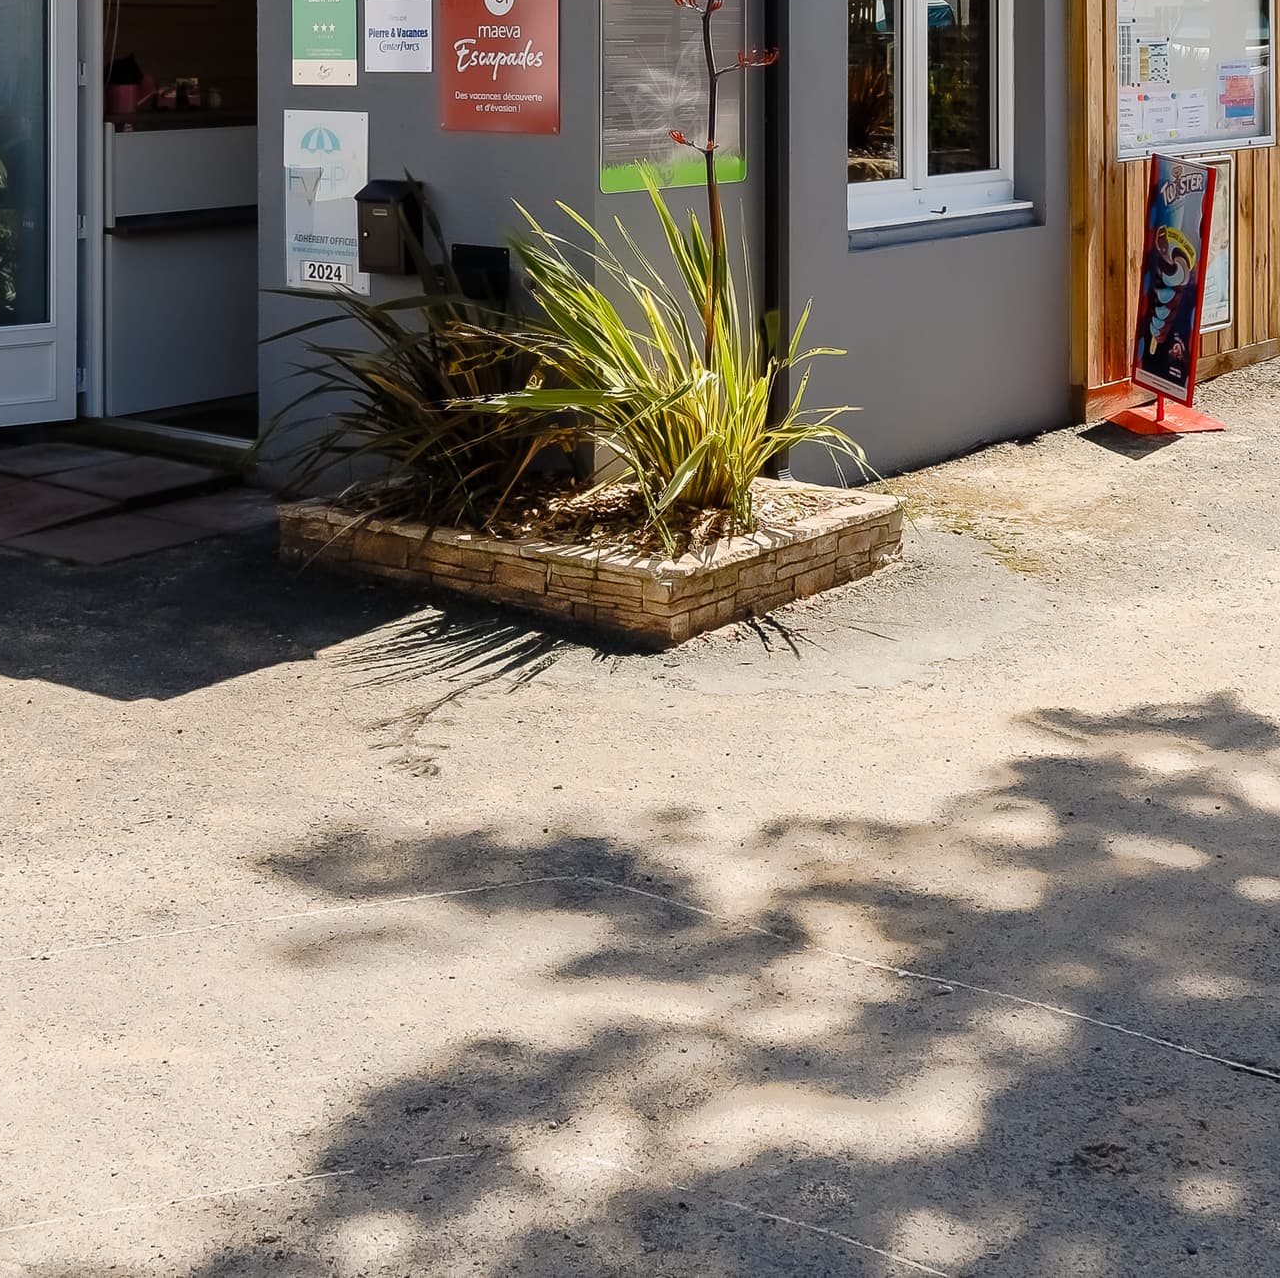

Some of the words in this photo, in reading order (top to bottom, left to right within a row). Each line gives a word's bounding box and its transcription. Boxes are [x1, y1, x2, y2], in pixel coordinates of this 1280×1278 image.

[368, 28, 390, 38] Pierre
[391, 28, 396, 37] &
[397, 27, 428, 38] Vacances
[478, 25, 520, 38] maeva
[453, 38, 544, 81] Escapades
[455, 91, 468, 100] Des
[469, 92, 501, 101] vacances
[502, 91, 542, 102] découverte
[476, 104, 483, 112] et
[484, 104, 517, 113] d'évasion
[308, 263, 342, 281] 2024
